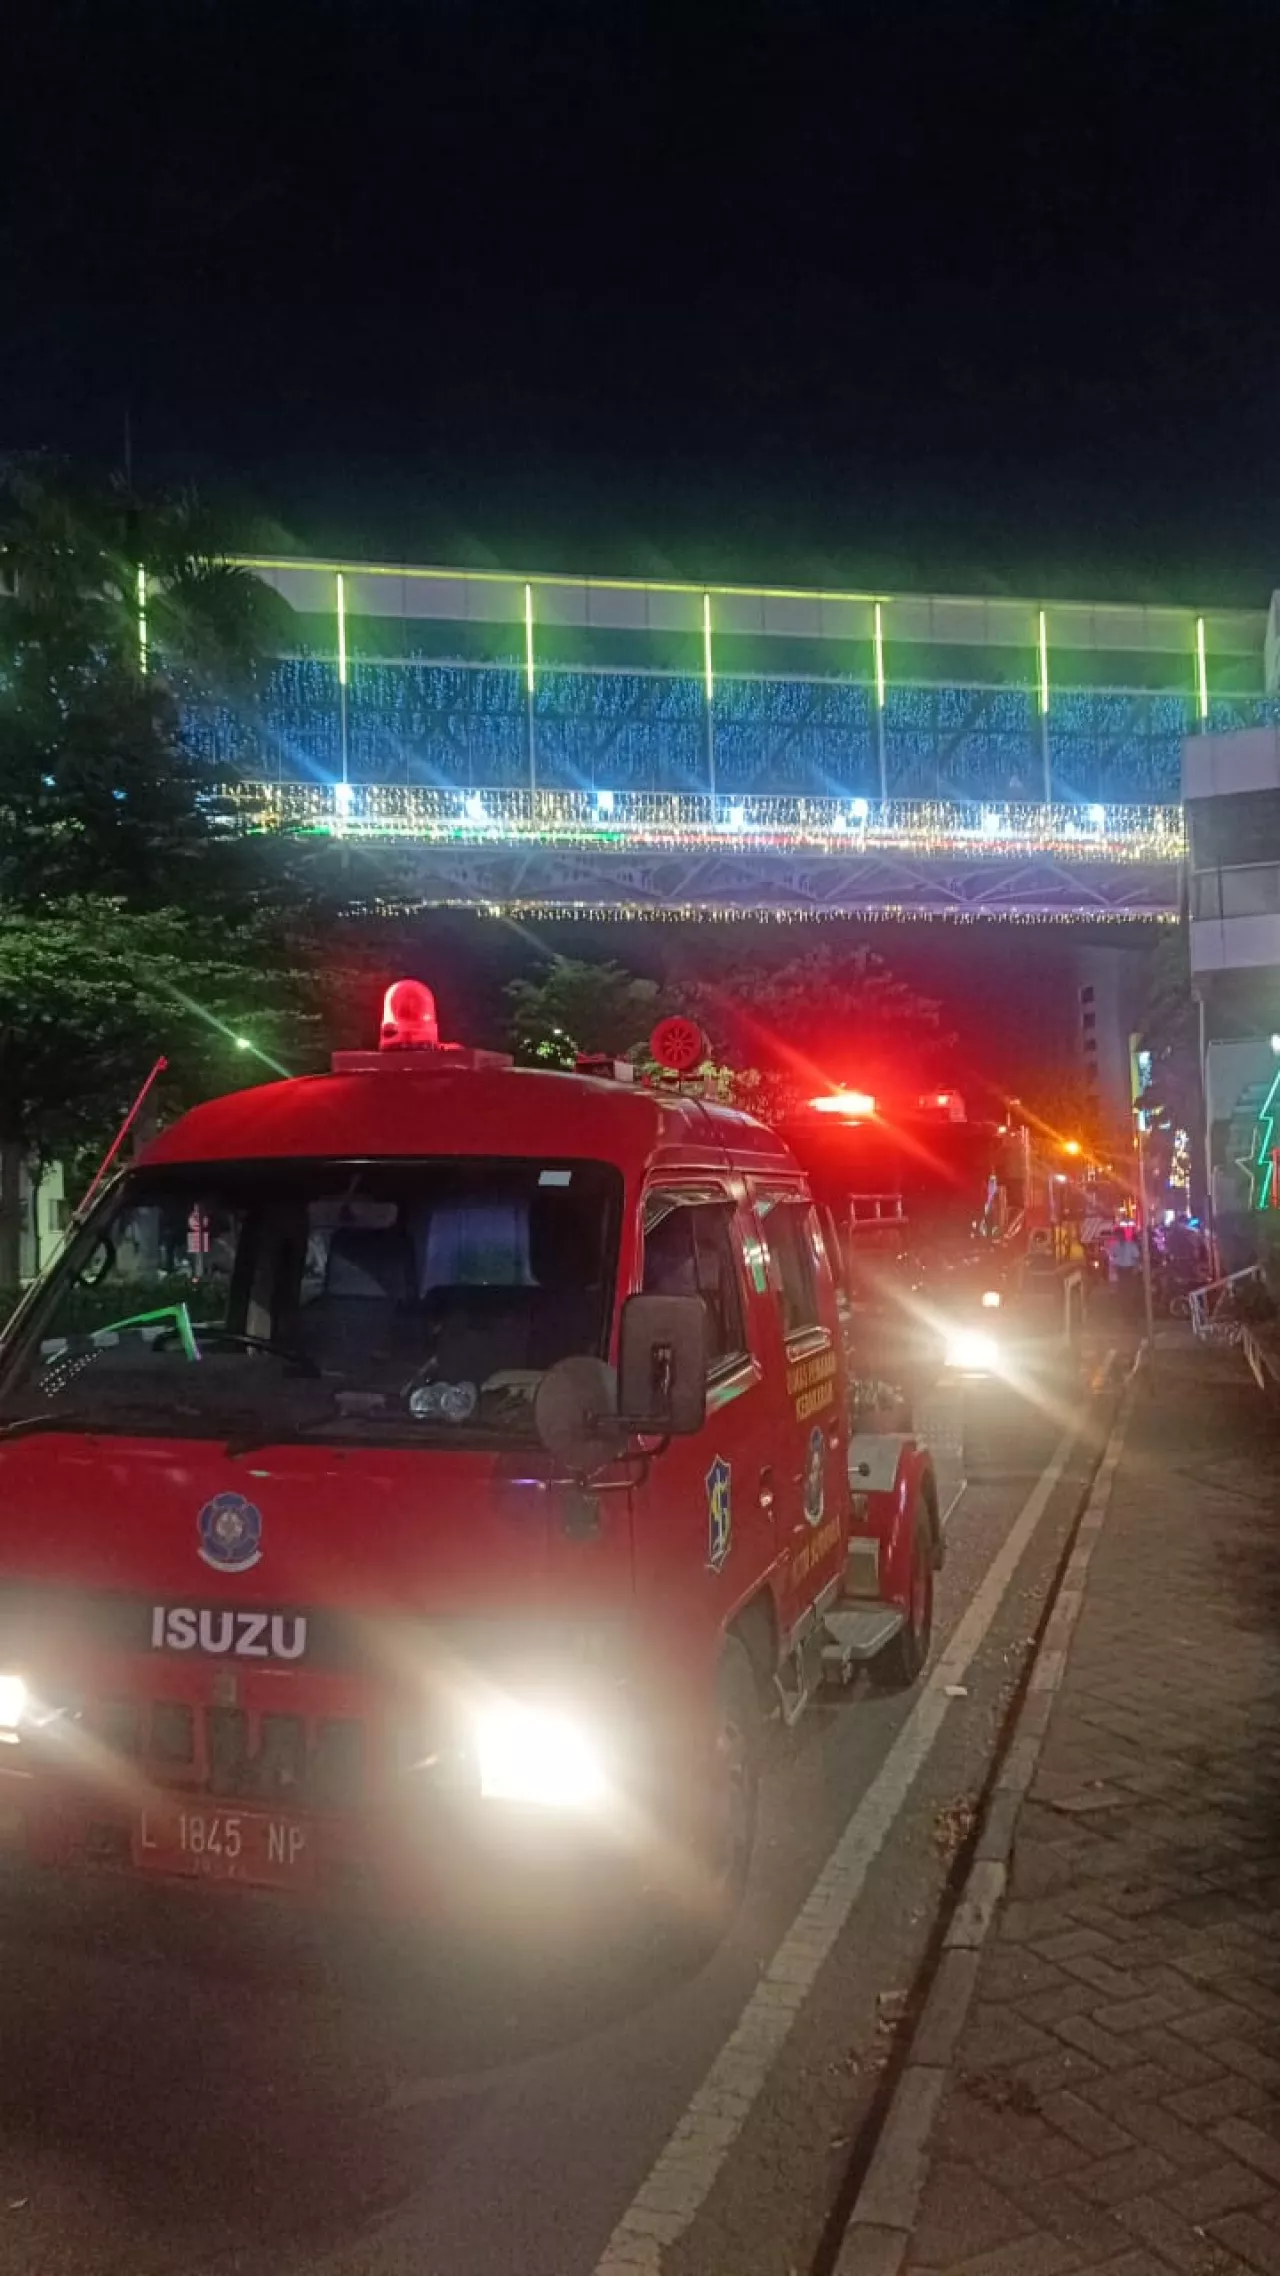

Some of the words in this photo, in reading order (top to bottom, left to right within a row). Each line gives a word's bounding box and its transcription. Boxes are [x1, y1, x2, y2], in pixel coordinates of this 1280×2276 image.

[152, 1606, 307, 1660] ISUZU
[141, 1811, 156, 1849] L
[178, 1812, 242, 1858] 1845
[268, 1821, 305, 1865] NP
